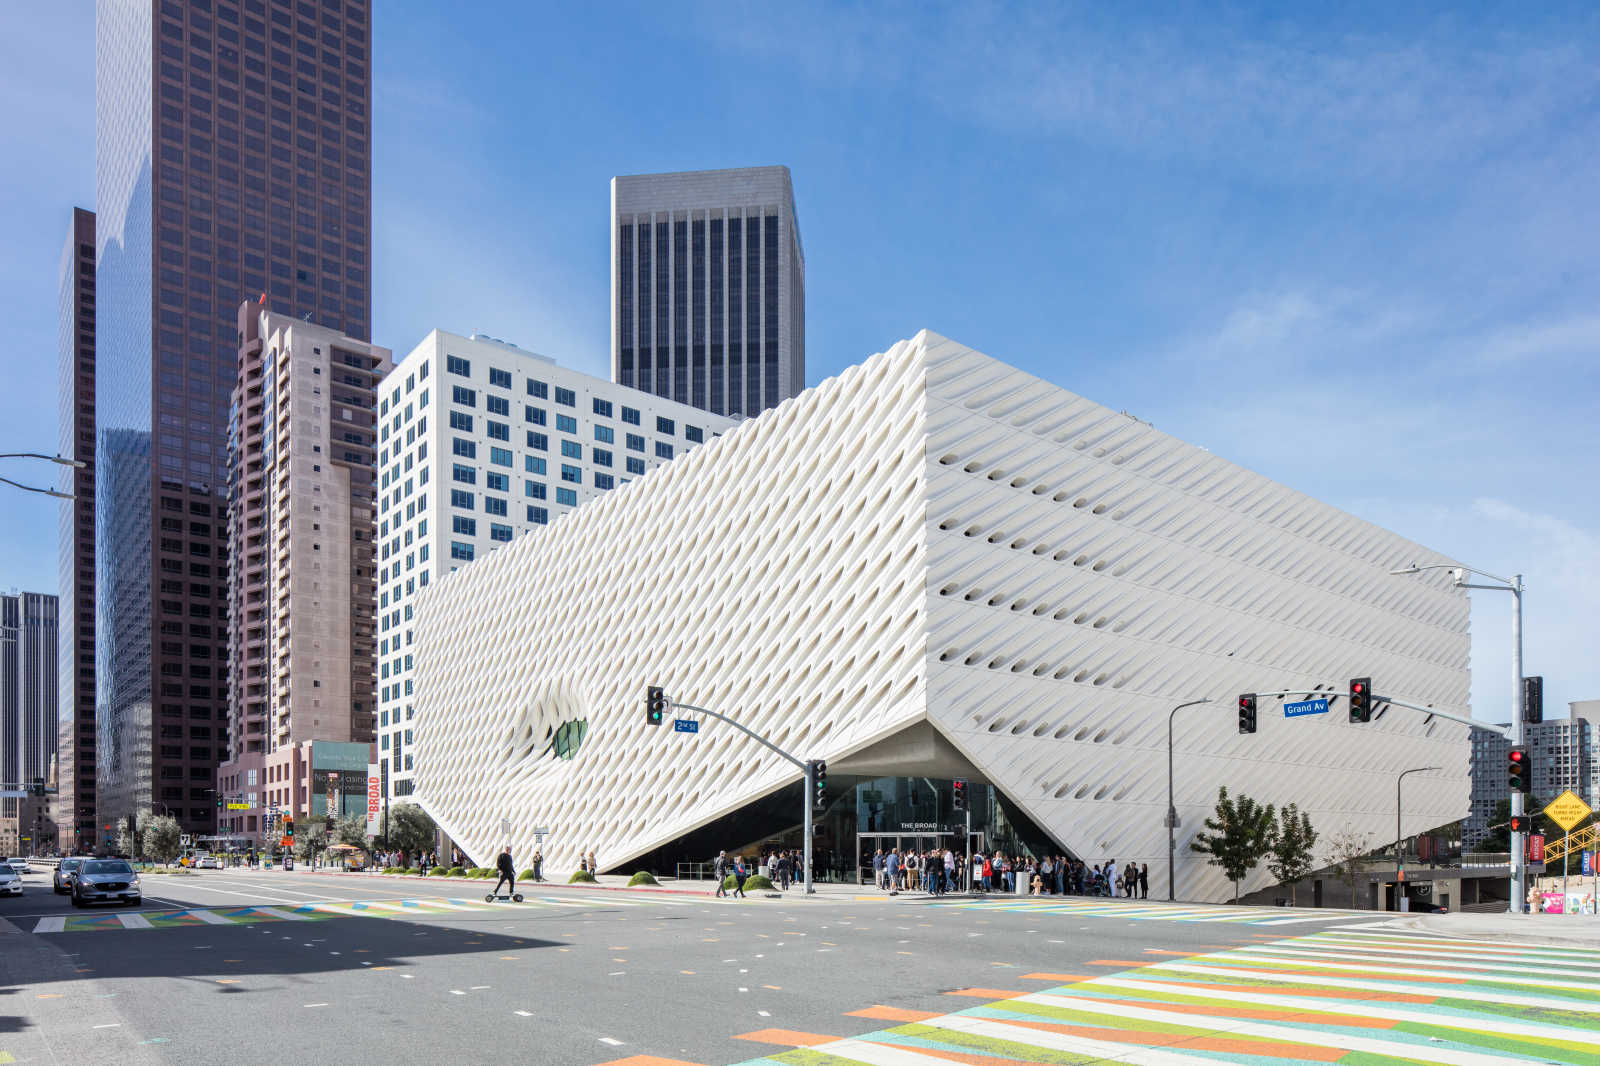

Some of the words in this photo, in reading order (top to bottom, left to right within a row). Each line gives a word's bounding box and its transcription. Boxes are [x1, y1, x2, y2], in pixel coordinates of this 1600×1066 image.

[1287, 704, 1311, 714] Grand
[678, 722, 688, 730] 2nd
[368, 777, 379, 812] BROAD
